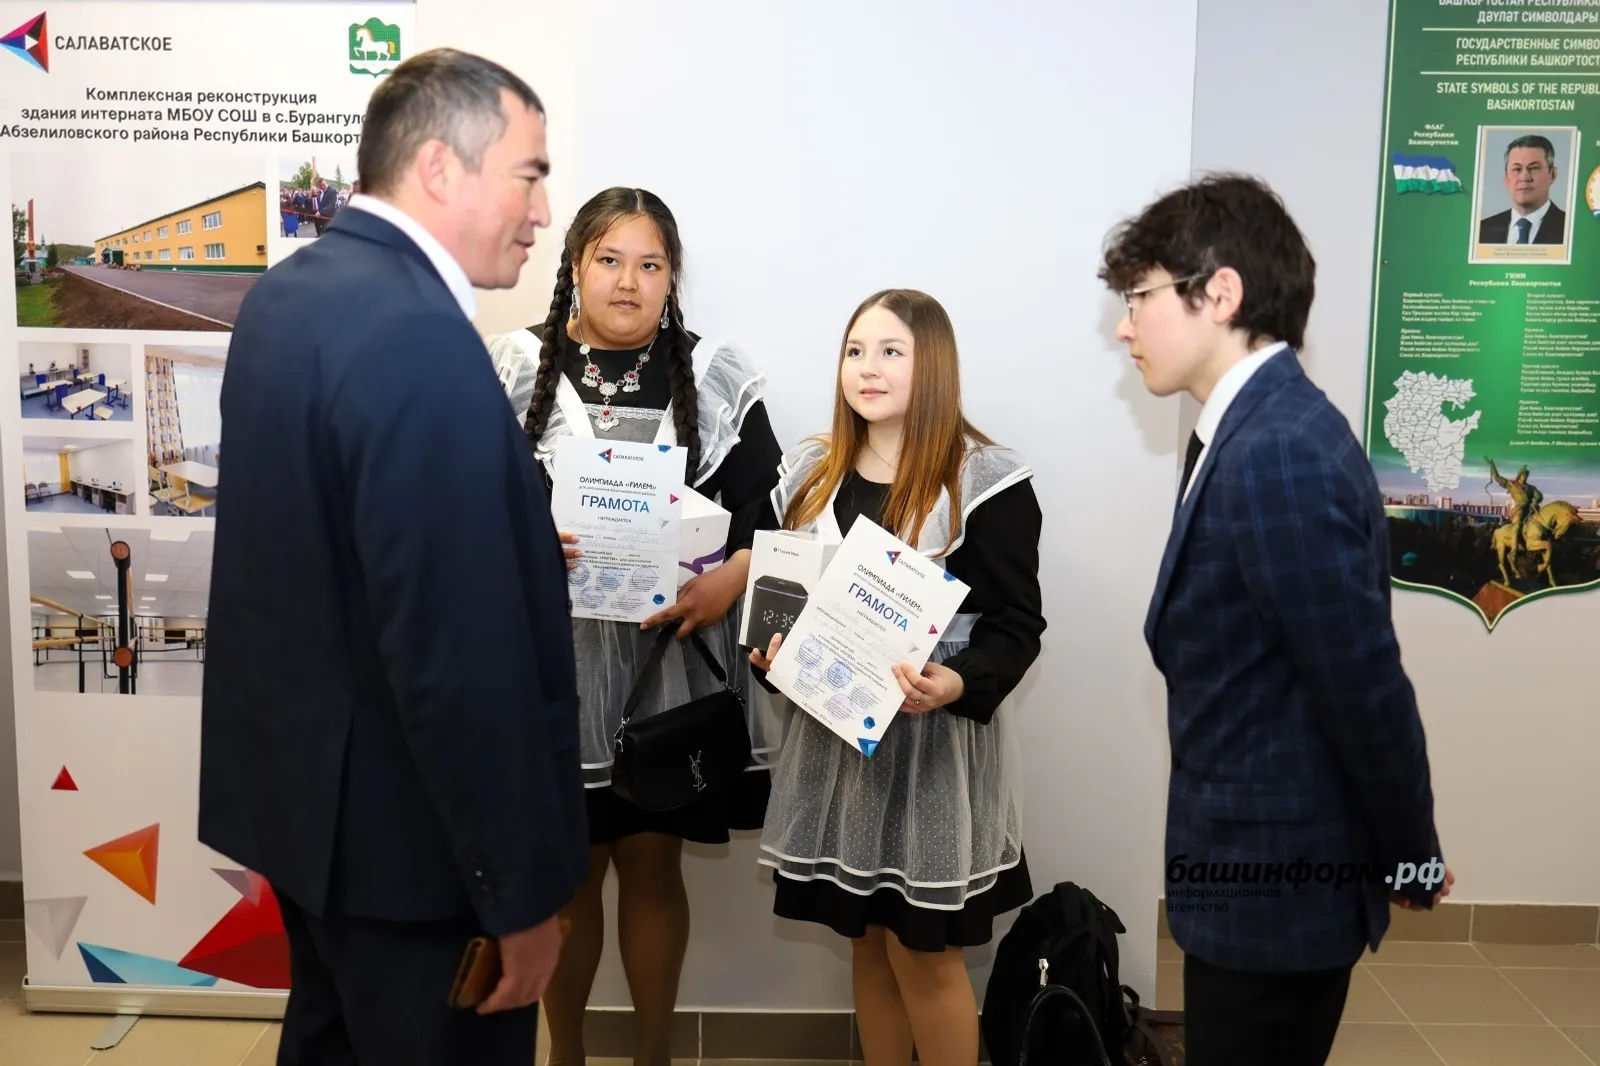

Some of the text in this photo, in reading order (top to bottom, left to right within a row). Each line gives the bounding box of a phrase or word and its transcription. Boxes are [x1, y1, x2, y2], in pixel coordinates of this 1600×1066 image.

[1521, 12, 1598, 24] СИМВОЛДАРЫ
[54, 35, 173, 52] САЛАВАТСКОЕ
[1456, 38, 1560, 50] ГОСУДАРСТВЕННЫЕ
[1456, 54, 1528, 66] РЕСПУБЛИКИ
[1436, 82, 1468, 94] STATE
[1470, 82, 1519, 94] SYMBOLS
[1522, 83, 1535, 94] OF
[1538, 83, 1557, 95] THE
[86, 87, 317, 106] Комплексная реконструкция
[1486, 99, 1575, 110] BASHKORTOSTAN
[21, 108, 77, 121] здания
[81, 109, 163, 123] интерната
[167, 108, 214, 121] МБОУ
[218, 109, 257, 122] СОШ
[262, 113, 271, 122] в
[0, 125, 129, 140] Абзелиловского
[134, 128, 189, 142] района
[194, 128, 288, 143] Республики
[579, 476, 624, 487] ОЛИМПИАДА
[581, 495, 650, 513] ГРАМОТА
[857, 564, 895, 594] ОЛИМПИАДА
[848, 582, 908, 632] ГРАМОТА
